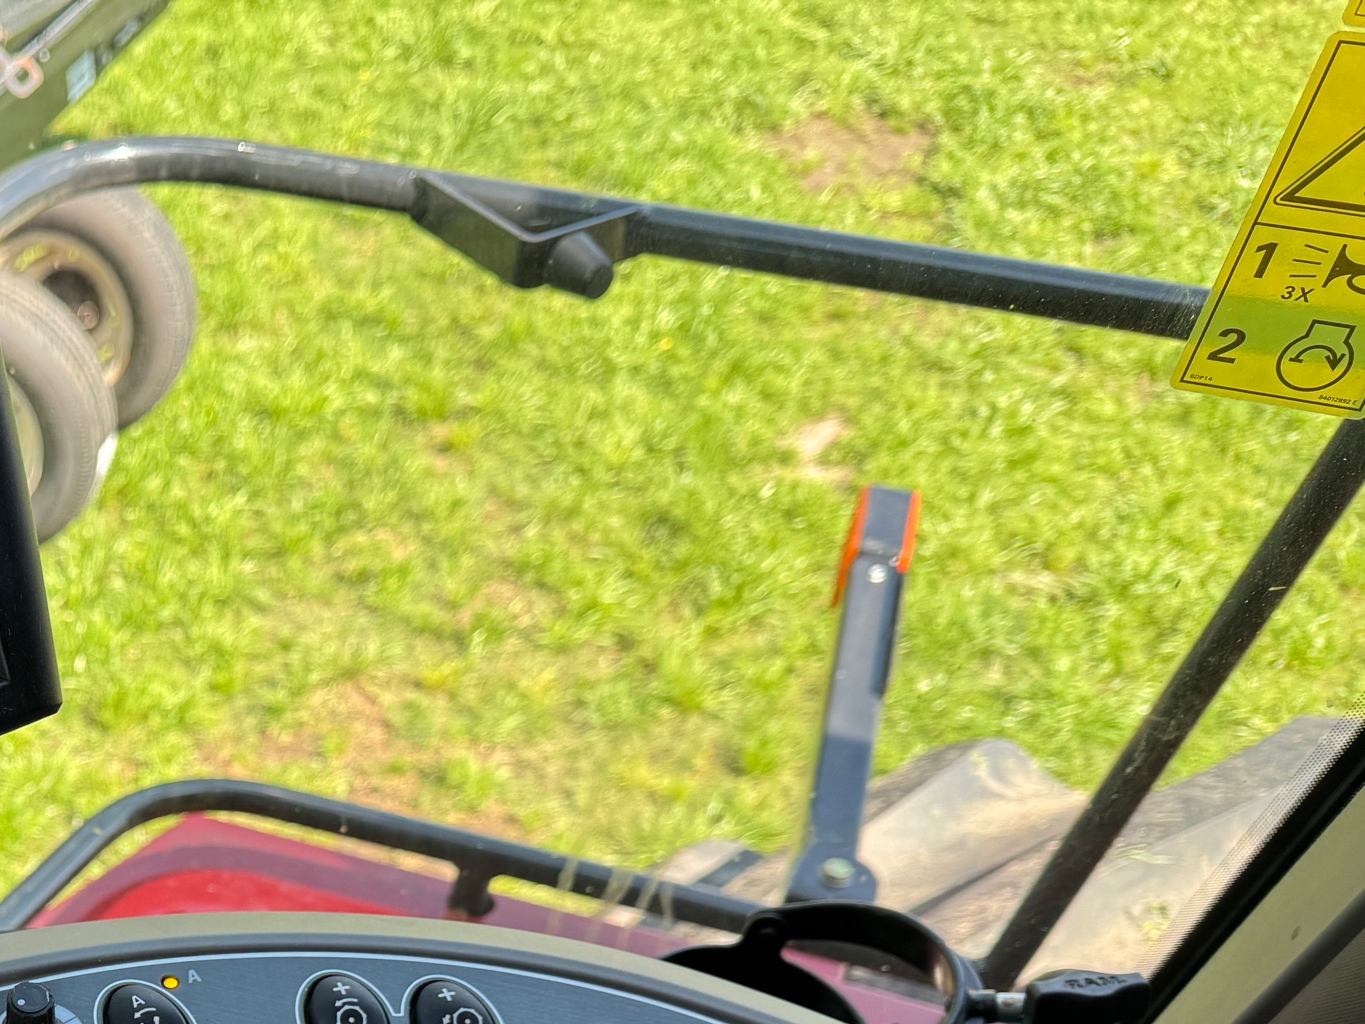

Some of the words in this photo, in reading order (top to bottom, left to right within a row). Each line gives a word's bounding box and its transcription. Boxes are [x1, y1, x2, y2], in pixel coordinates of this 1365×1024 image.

[1253, 242, 1280, 278] 1
[1280, 285, 1316, 303] 3X
[1207, 328, 1247, 364] 2
[188, 969, 202, 983] A
[131, 995, 146, 1009] A
